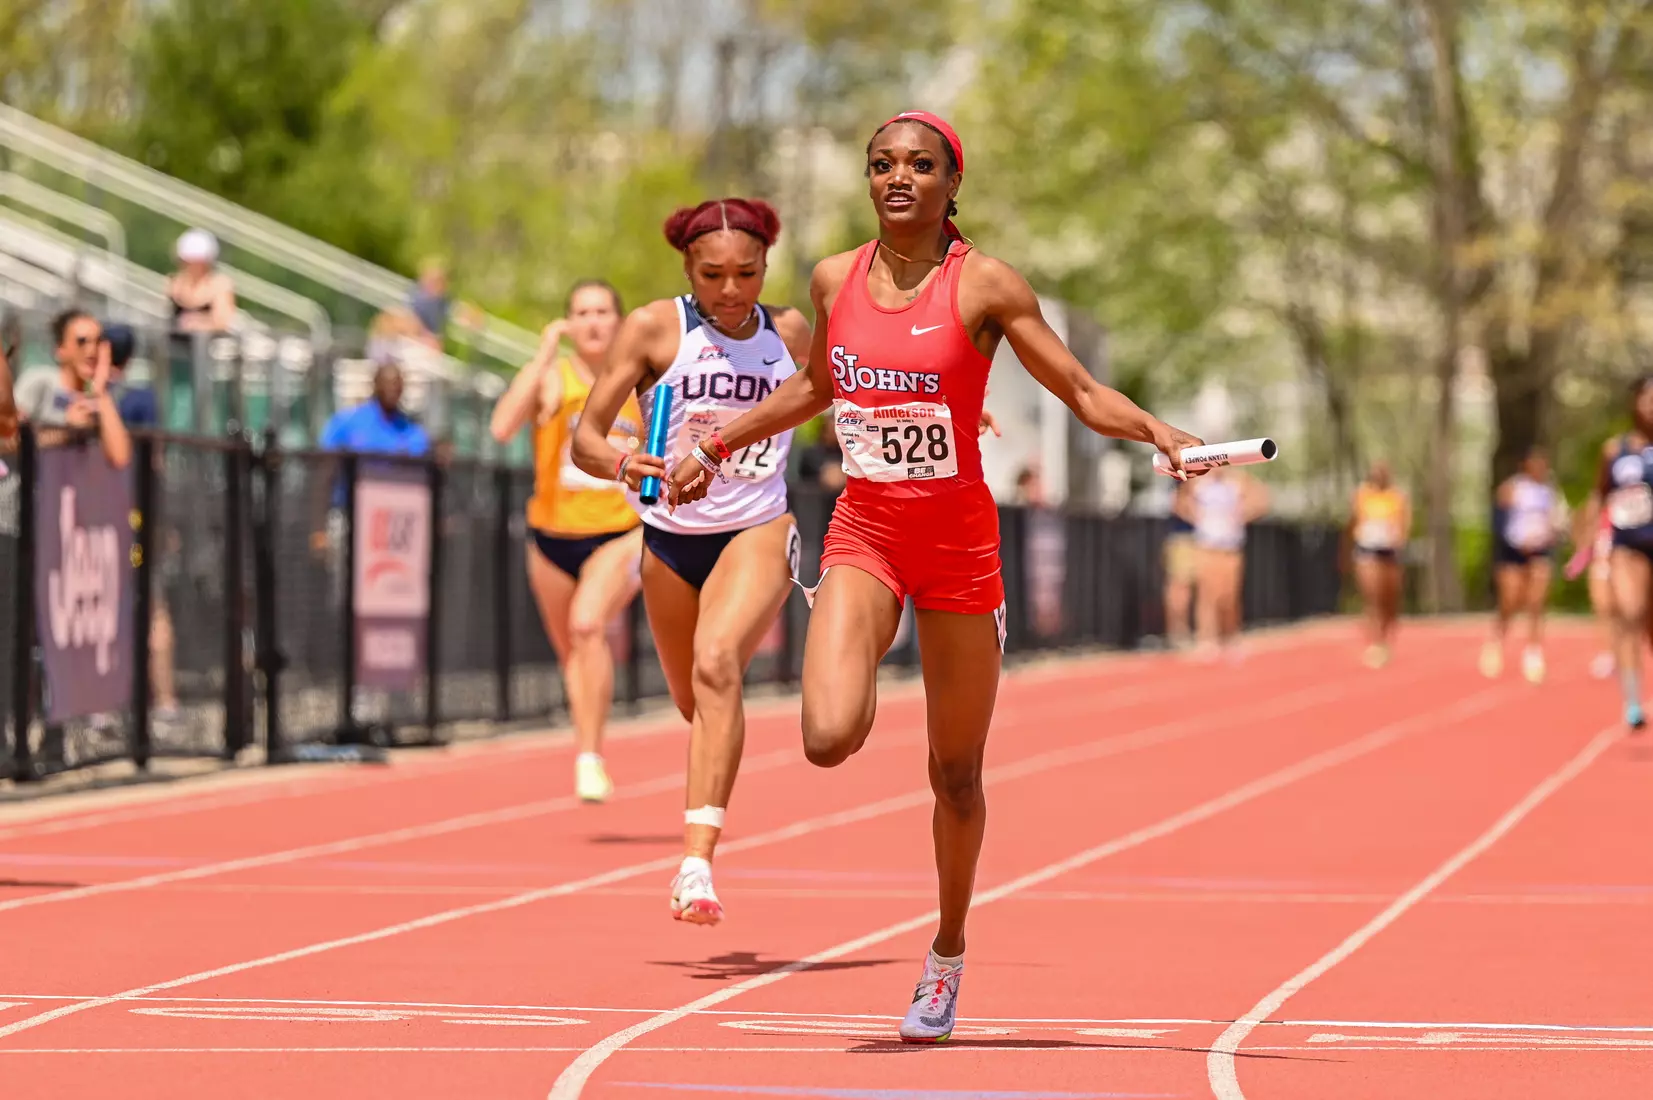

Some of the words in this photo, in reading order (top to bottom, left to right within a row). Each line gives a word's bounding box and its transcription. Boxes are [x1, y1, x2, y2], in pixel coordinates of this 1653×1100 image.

[838, 365, 940, 394] JOHN'S
[682, 373, 779, 402] UCON
[839, 411, 858, 419] BIG
[873, 407, 935, 419] Anderson
[837, 417, 863, 425] EAST
[882, 424, 949, 465] 528
[1185, 456, 1207, 464] POMPEY
[1208, 453, 1228, 462] ALIANN
[48, 486, 119, 676] Jeep
